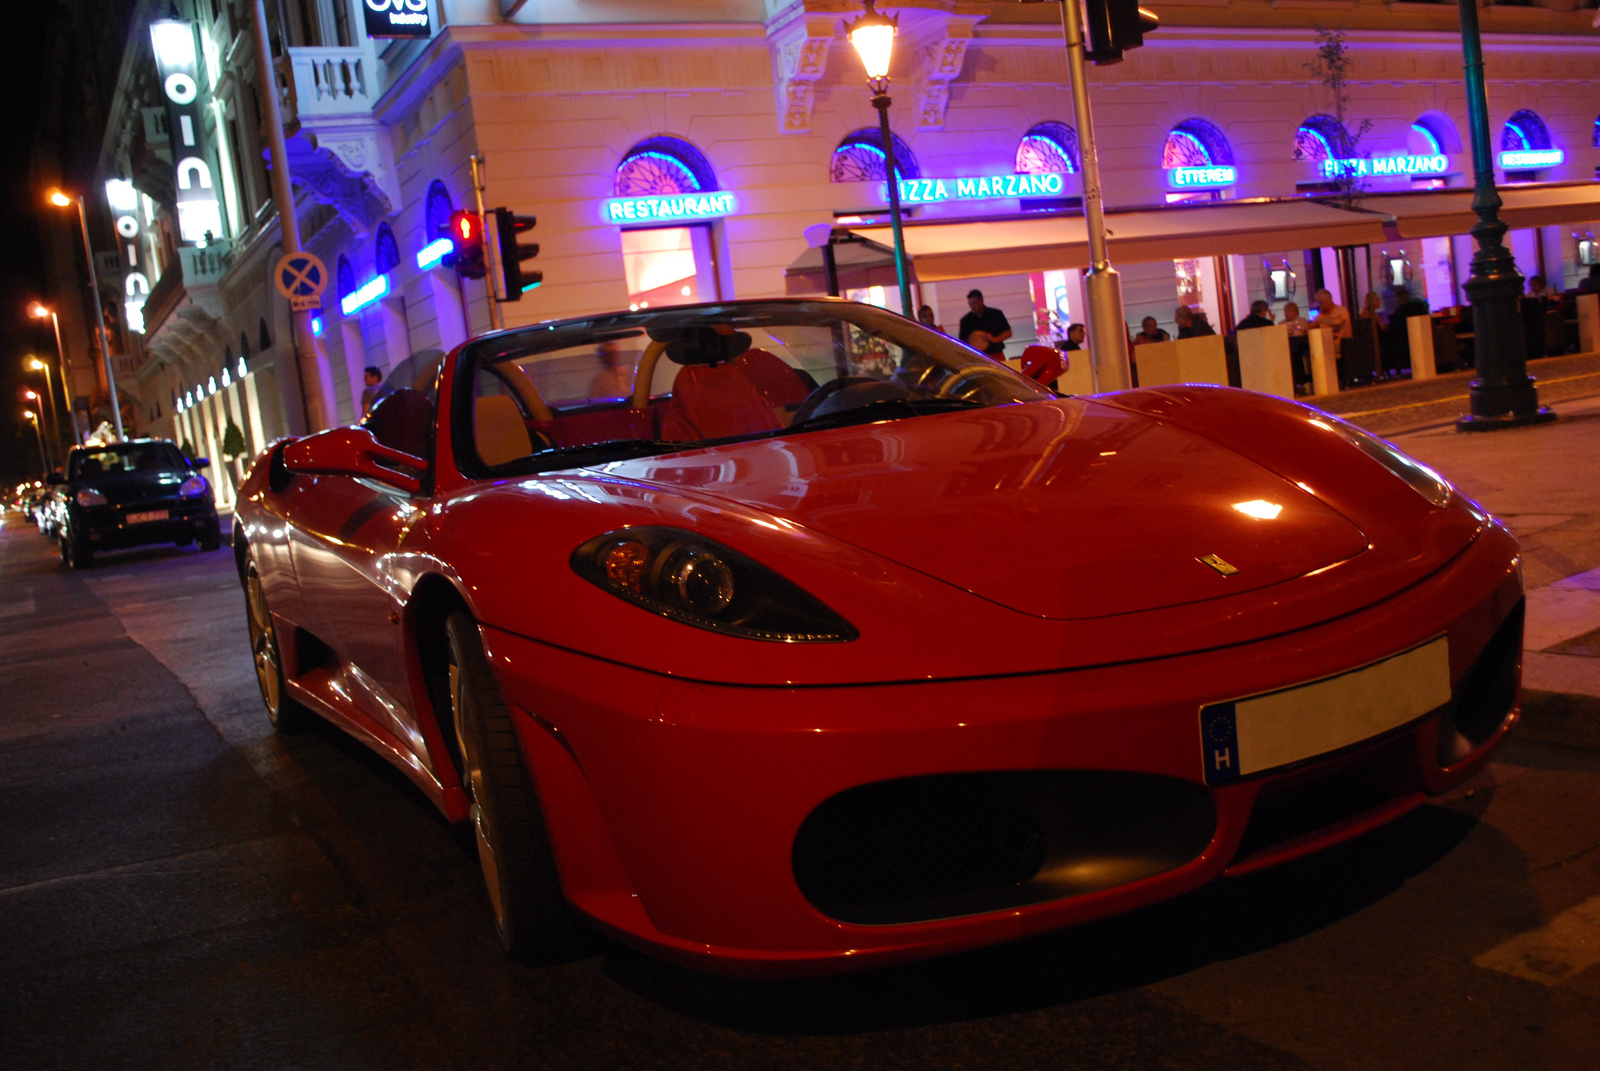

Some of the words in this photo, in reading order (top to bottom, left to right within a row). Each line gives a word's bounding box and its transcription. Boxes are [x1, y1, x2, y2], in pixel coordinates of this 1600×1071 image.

[1372, 156, 1447, 175] MARZANO
[884, 179, 948, 202] IZZA
[956, 172, 1063, 198] MARZANO
[608, 194, 734, 220] RESTAURANT
[1214, 747, 1231, 771] H
